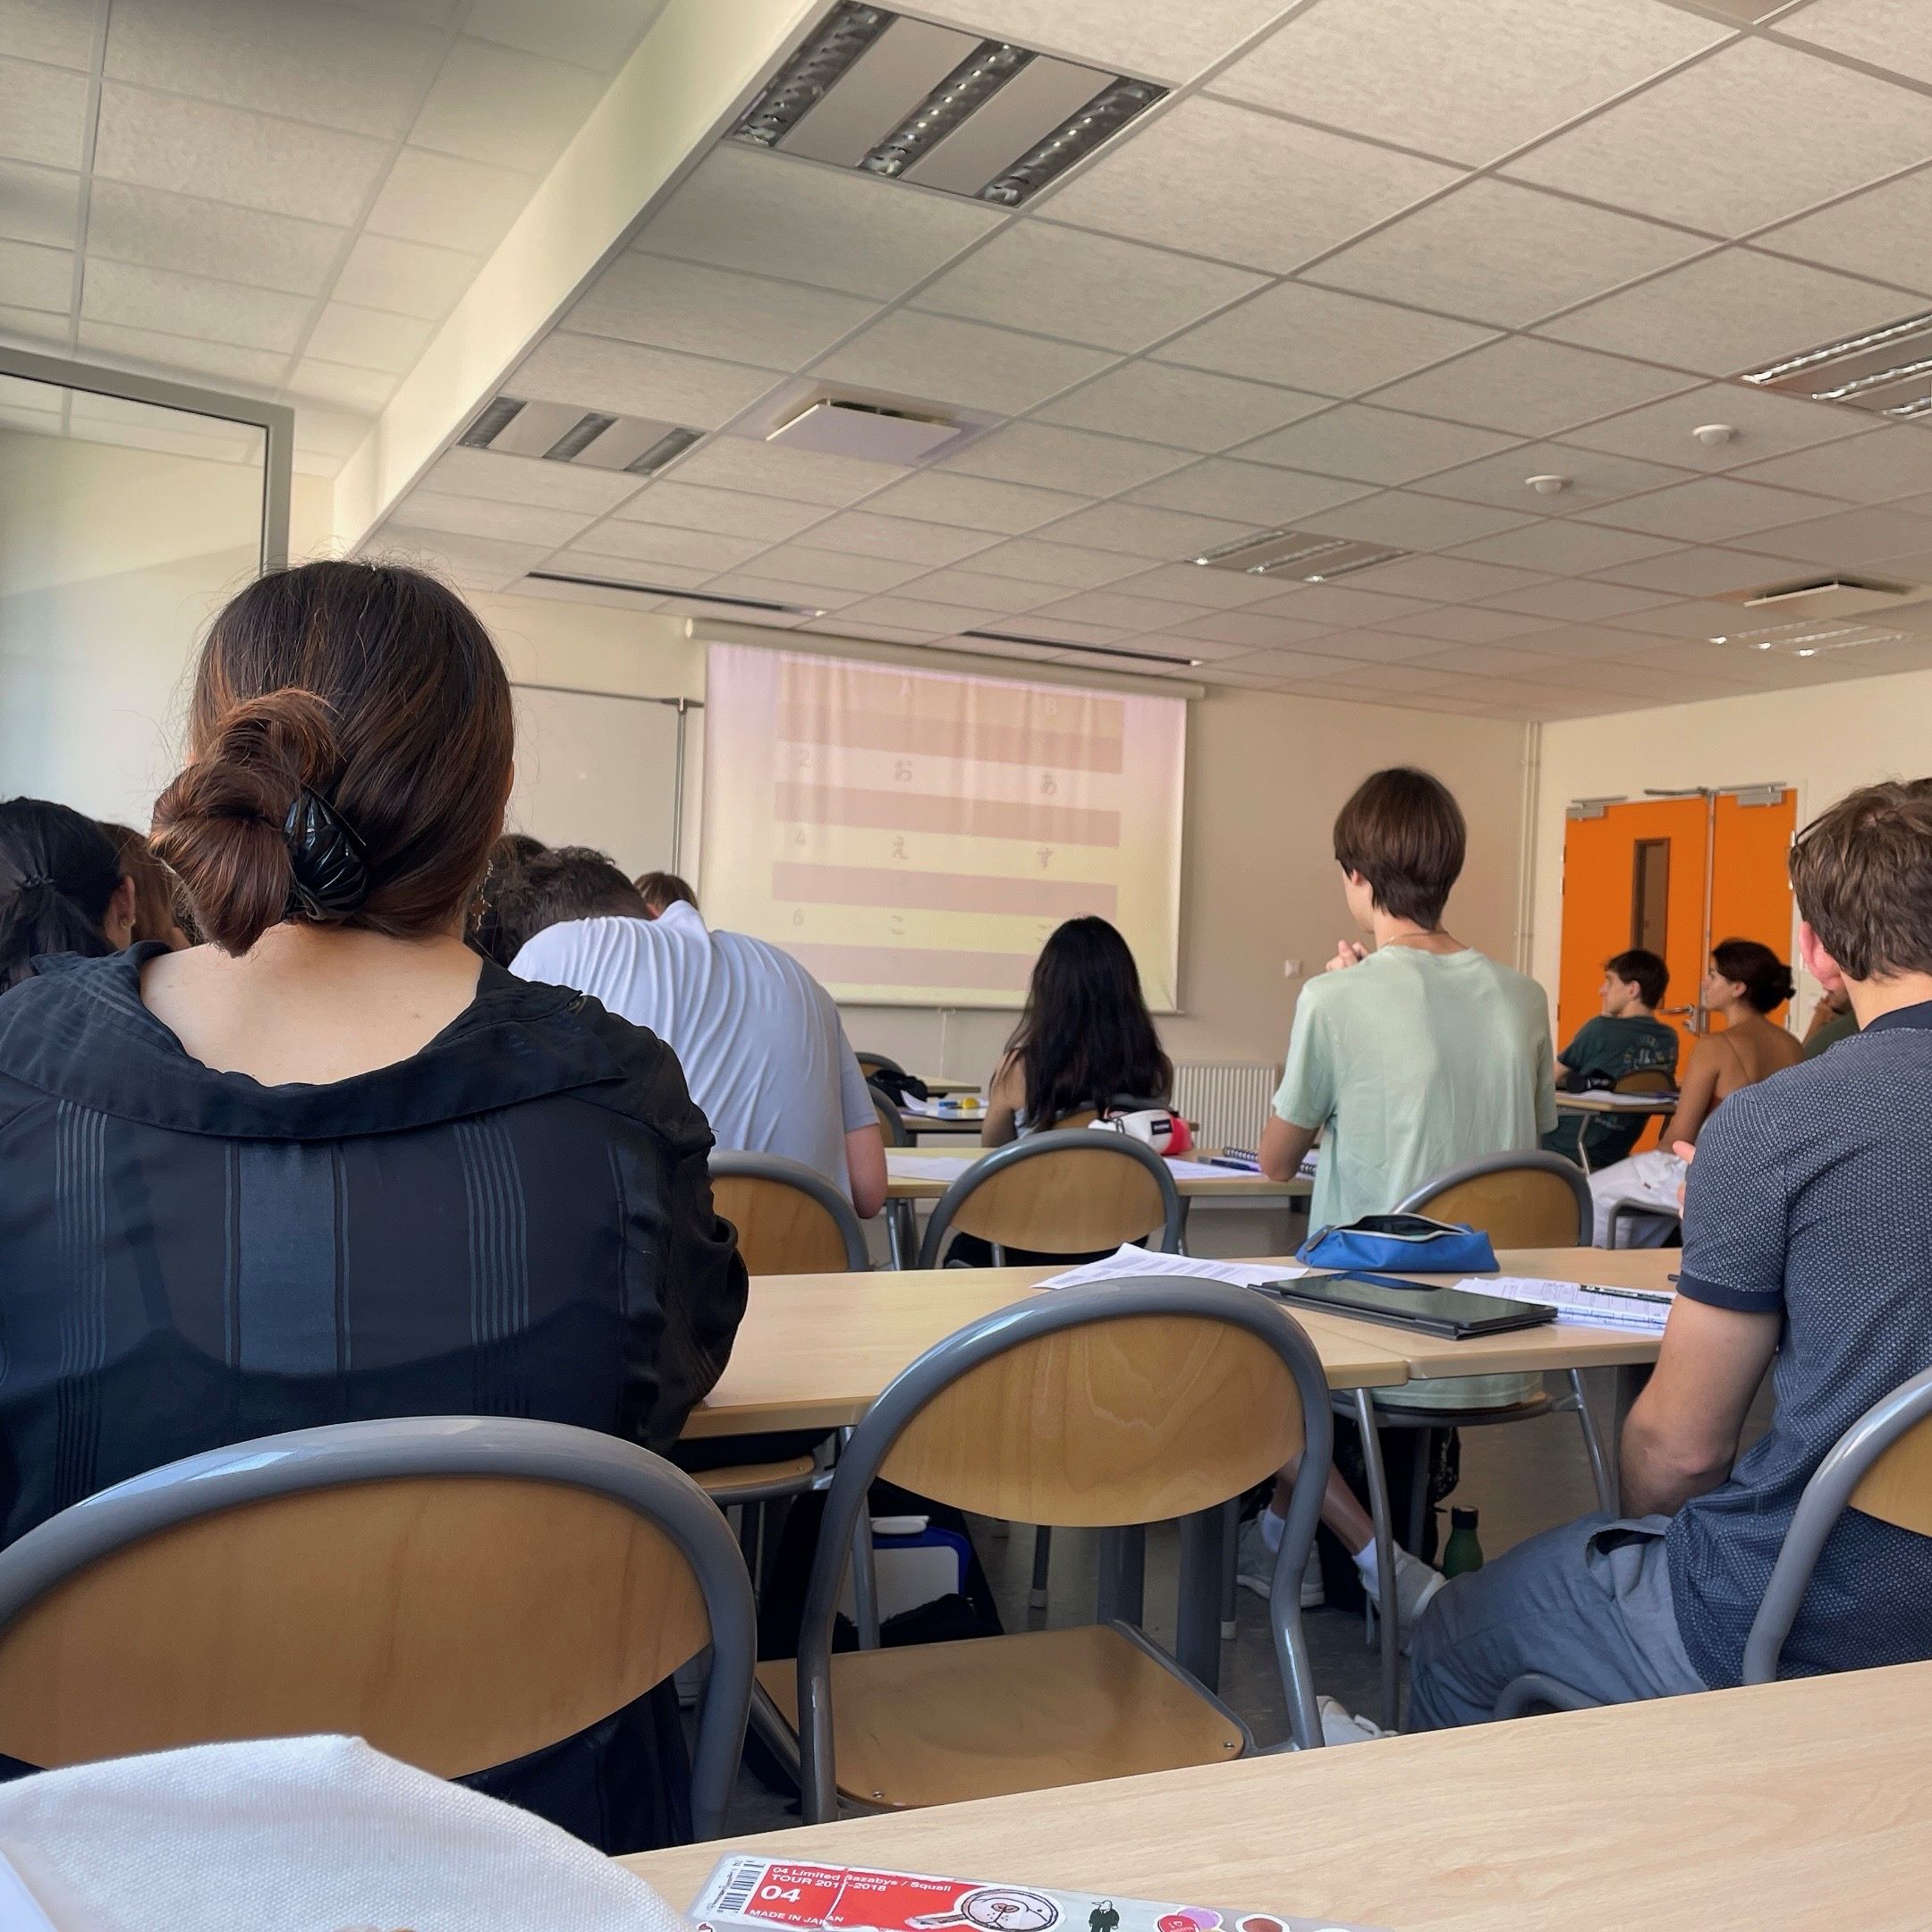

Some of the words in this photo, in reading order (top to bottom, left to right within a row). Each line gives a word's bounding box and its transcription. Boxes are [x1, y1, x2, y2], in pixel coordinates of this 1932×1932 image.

[893, 759, 913, 783] お
[1039, 773, 1057, 796] あ
[890, 835, 909, 860] え
[1036, 847, 1055, 869] す
[771, 1874, 813, 1885] TOUR
[792, 1868, 841, 1881] Limited
[910, 1881, 952, 1893] Squall
[760, 1885, 801, 1902] 04
[749, 1910, 786, 1919] MADE
